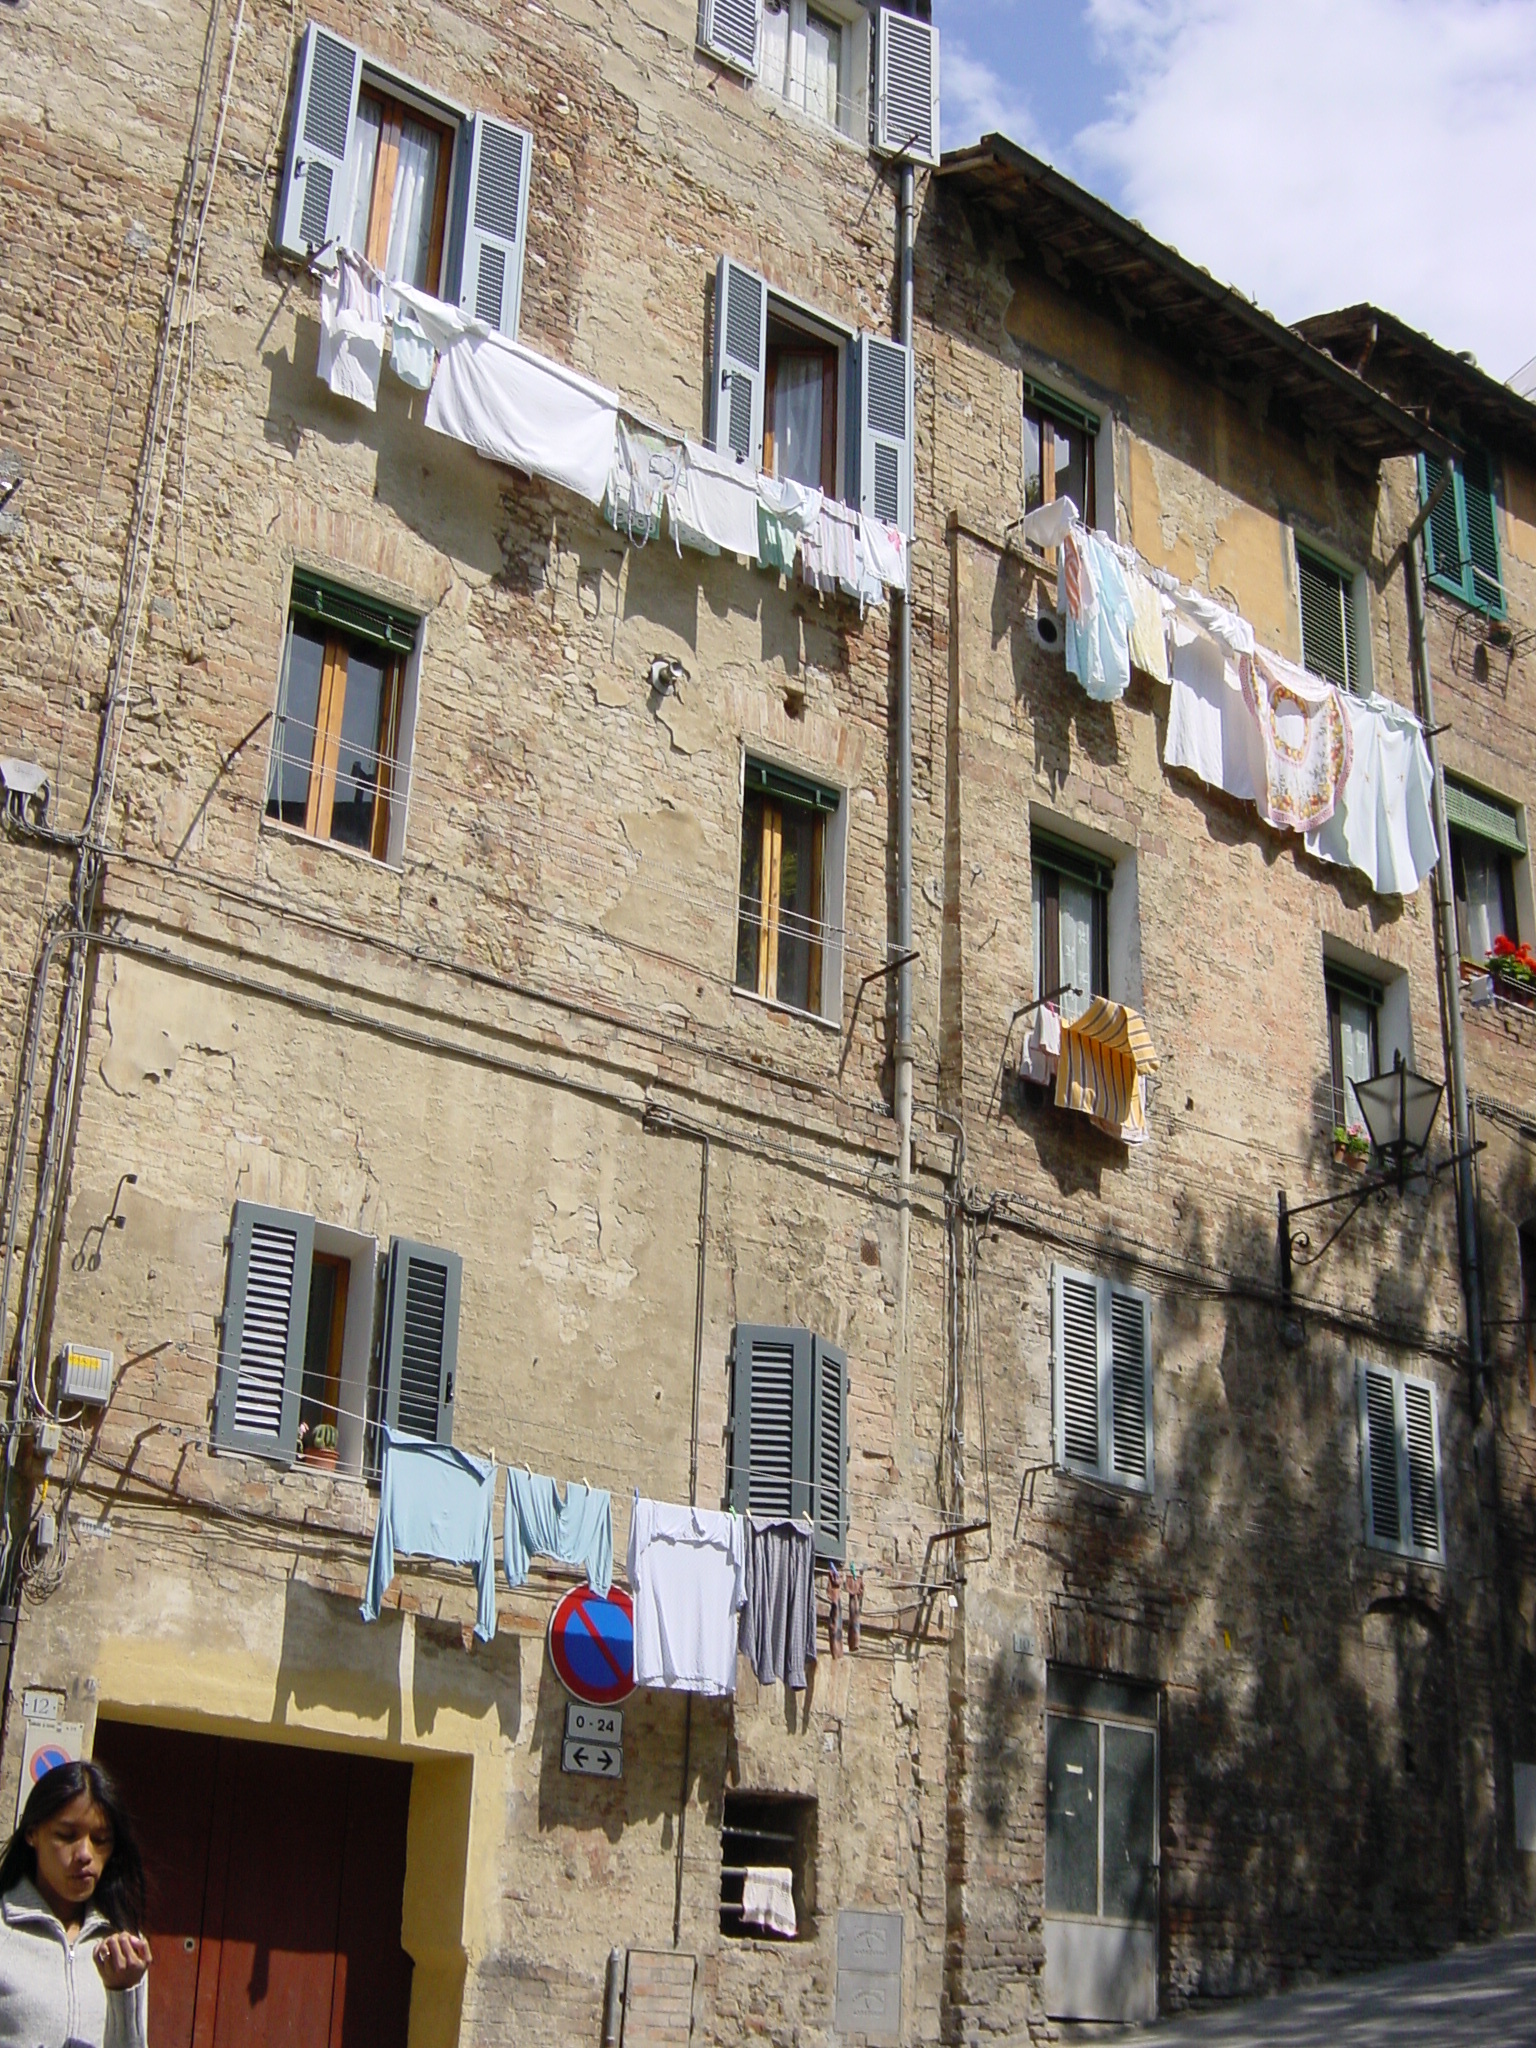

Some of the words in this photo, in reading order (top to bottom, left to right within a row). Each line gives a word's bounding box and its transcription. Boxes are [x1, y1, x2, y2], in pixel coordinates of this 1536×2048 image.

[32, 1698, 49, 1714] 12
[576, 1715, 584, 1728] 0
[597, 1719, 614, 1732] 24
